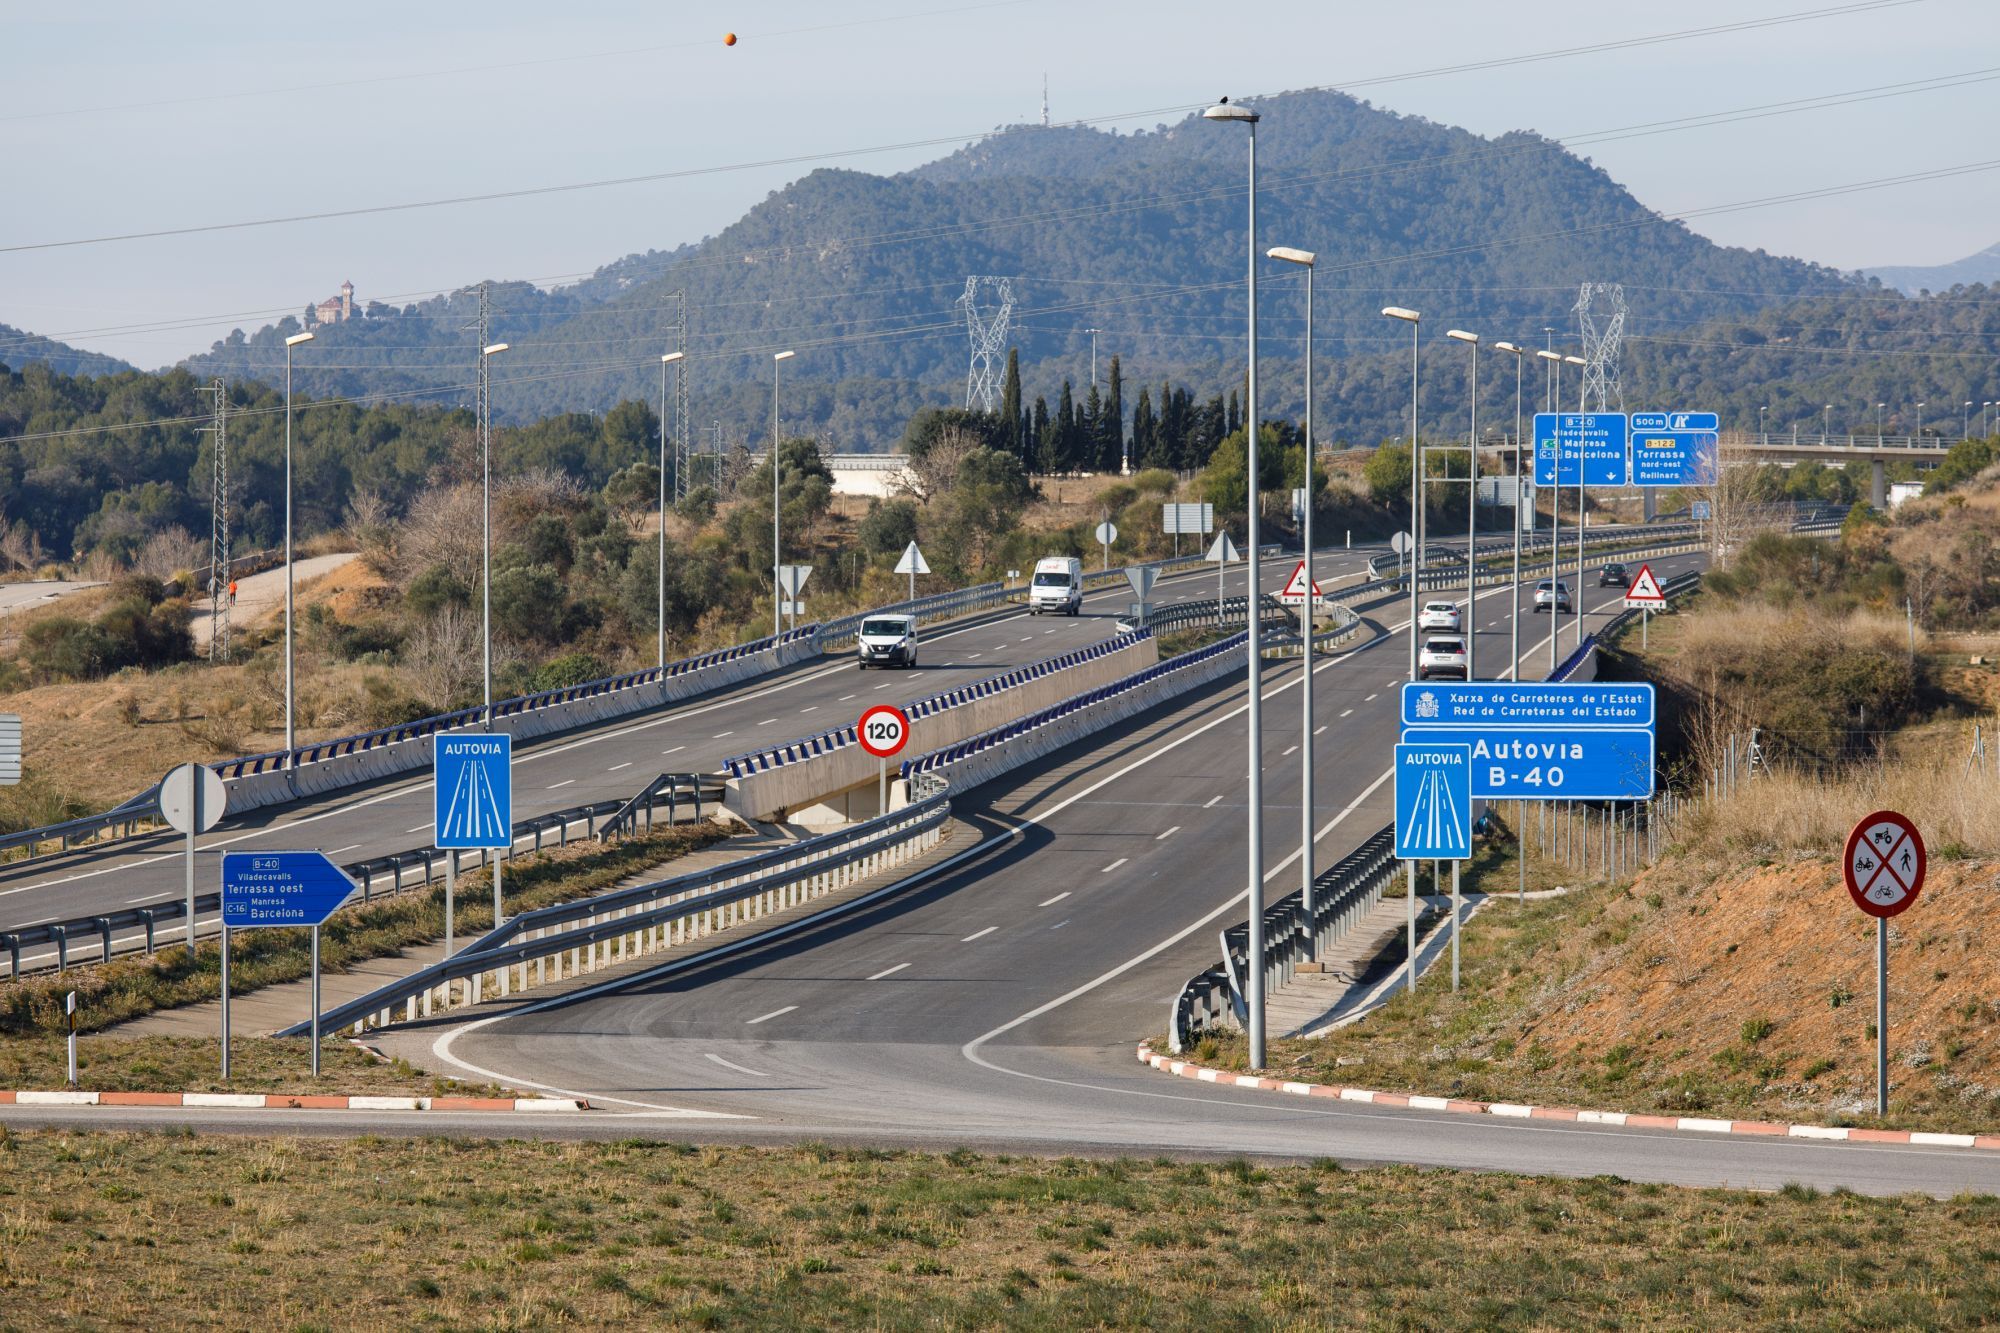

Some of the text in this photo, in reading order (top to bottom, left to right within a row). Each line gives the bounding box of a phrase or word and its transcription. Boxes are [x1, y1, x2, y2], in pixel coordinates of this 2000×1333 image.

[1635, 418, 1654, 426] 500
[1551, 429, 1609, 437] Vladecavalls
[1564, 439, 1607, 448] Manresa
[1564, 450, 1621, 459] Barcelona
[1636, 450, 1686, 459] Terrassa
[1641, 460, 1681, 468] nord-oest
[1640, 471, 1680, 479] Rellinars
[1449, 693, 1643, 704] Xarxa de Carreteres de l'Estat
[1453, 705, 1637, 716] Red de Carreteras del Estado
[868, 722, 899, 740] 120
[444, 743, 502, 755] AUTOVIA
[1472, 738, 1584, 760] Autovia
[1405, 753, 1462, 765] AUTOVIA
[1489, 766, 1564, 787] B-40
[254, 860, 278, 869] B-40
[237, 872, 292, 880] Viladecavalls
[227, 883, 303, 894] Terrassa oest
[251, 898, 285, 906] Manresa
[227, 904, 245, 913] C-16
[251, 908, 304, 918] Barcelona
